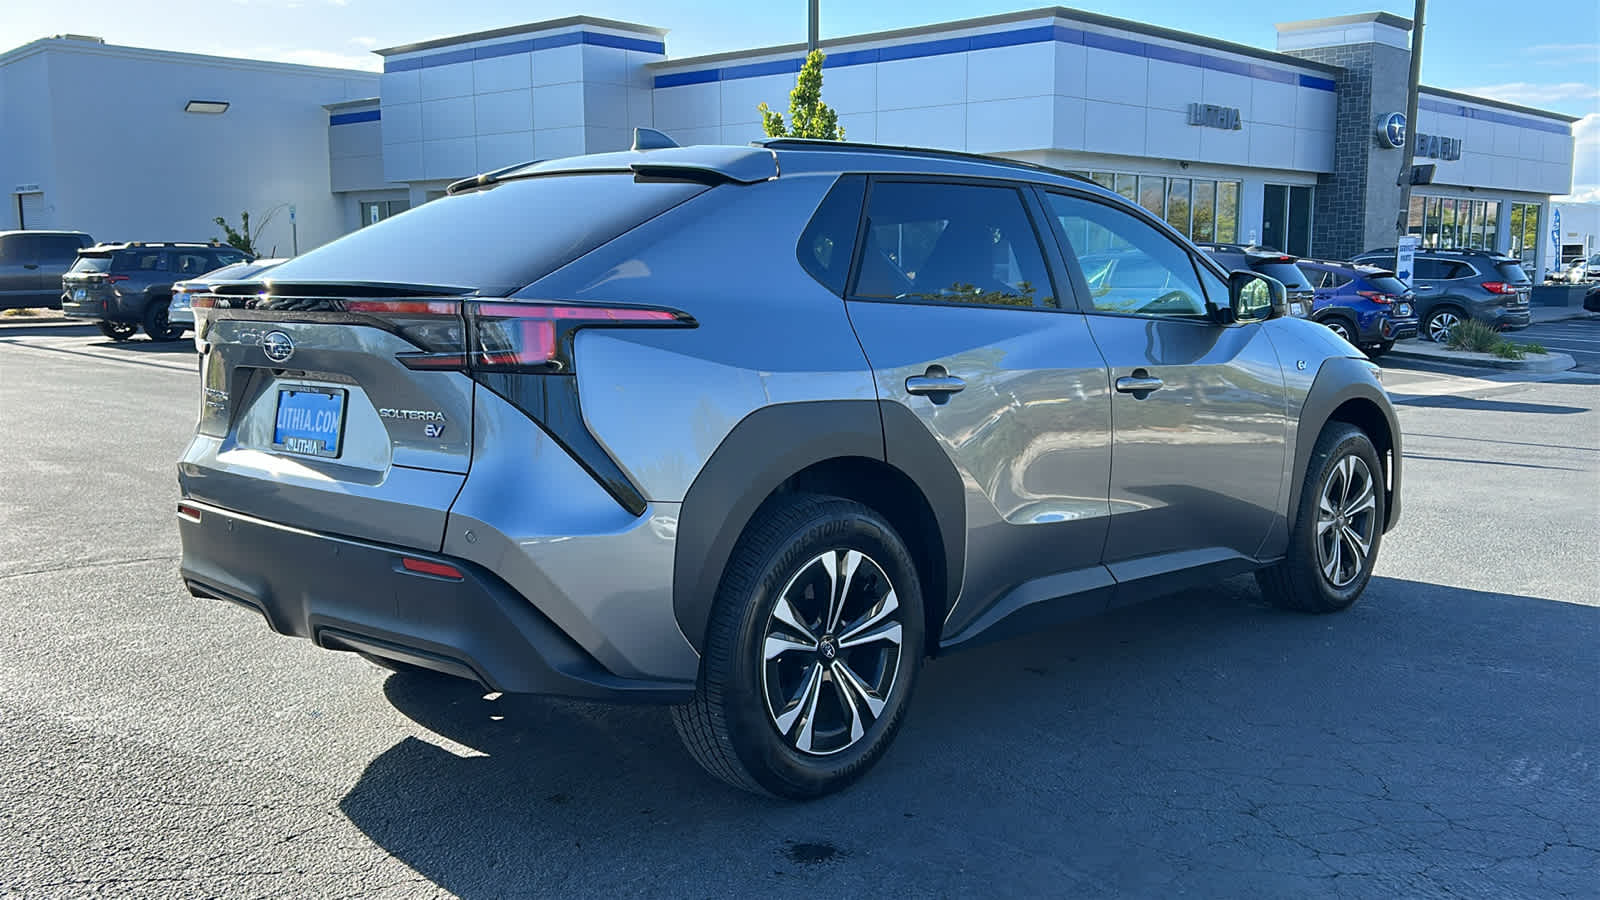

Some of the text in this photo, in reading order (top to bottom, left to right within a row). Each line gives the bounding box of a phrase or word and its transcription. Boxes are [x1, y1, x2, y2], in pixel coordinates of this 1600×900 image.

[1186, 102, 1242, 131] LITHIA
[1415, 133, 1462, 161] BARU
[277, 407, 340, 434] LITHIA.COM
[379, 408, 446, 421] SOLTERRA
[424, 424, 444, 438] EV
[293, 438, 319, 454] LITHIA
